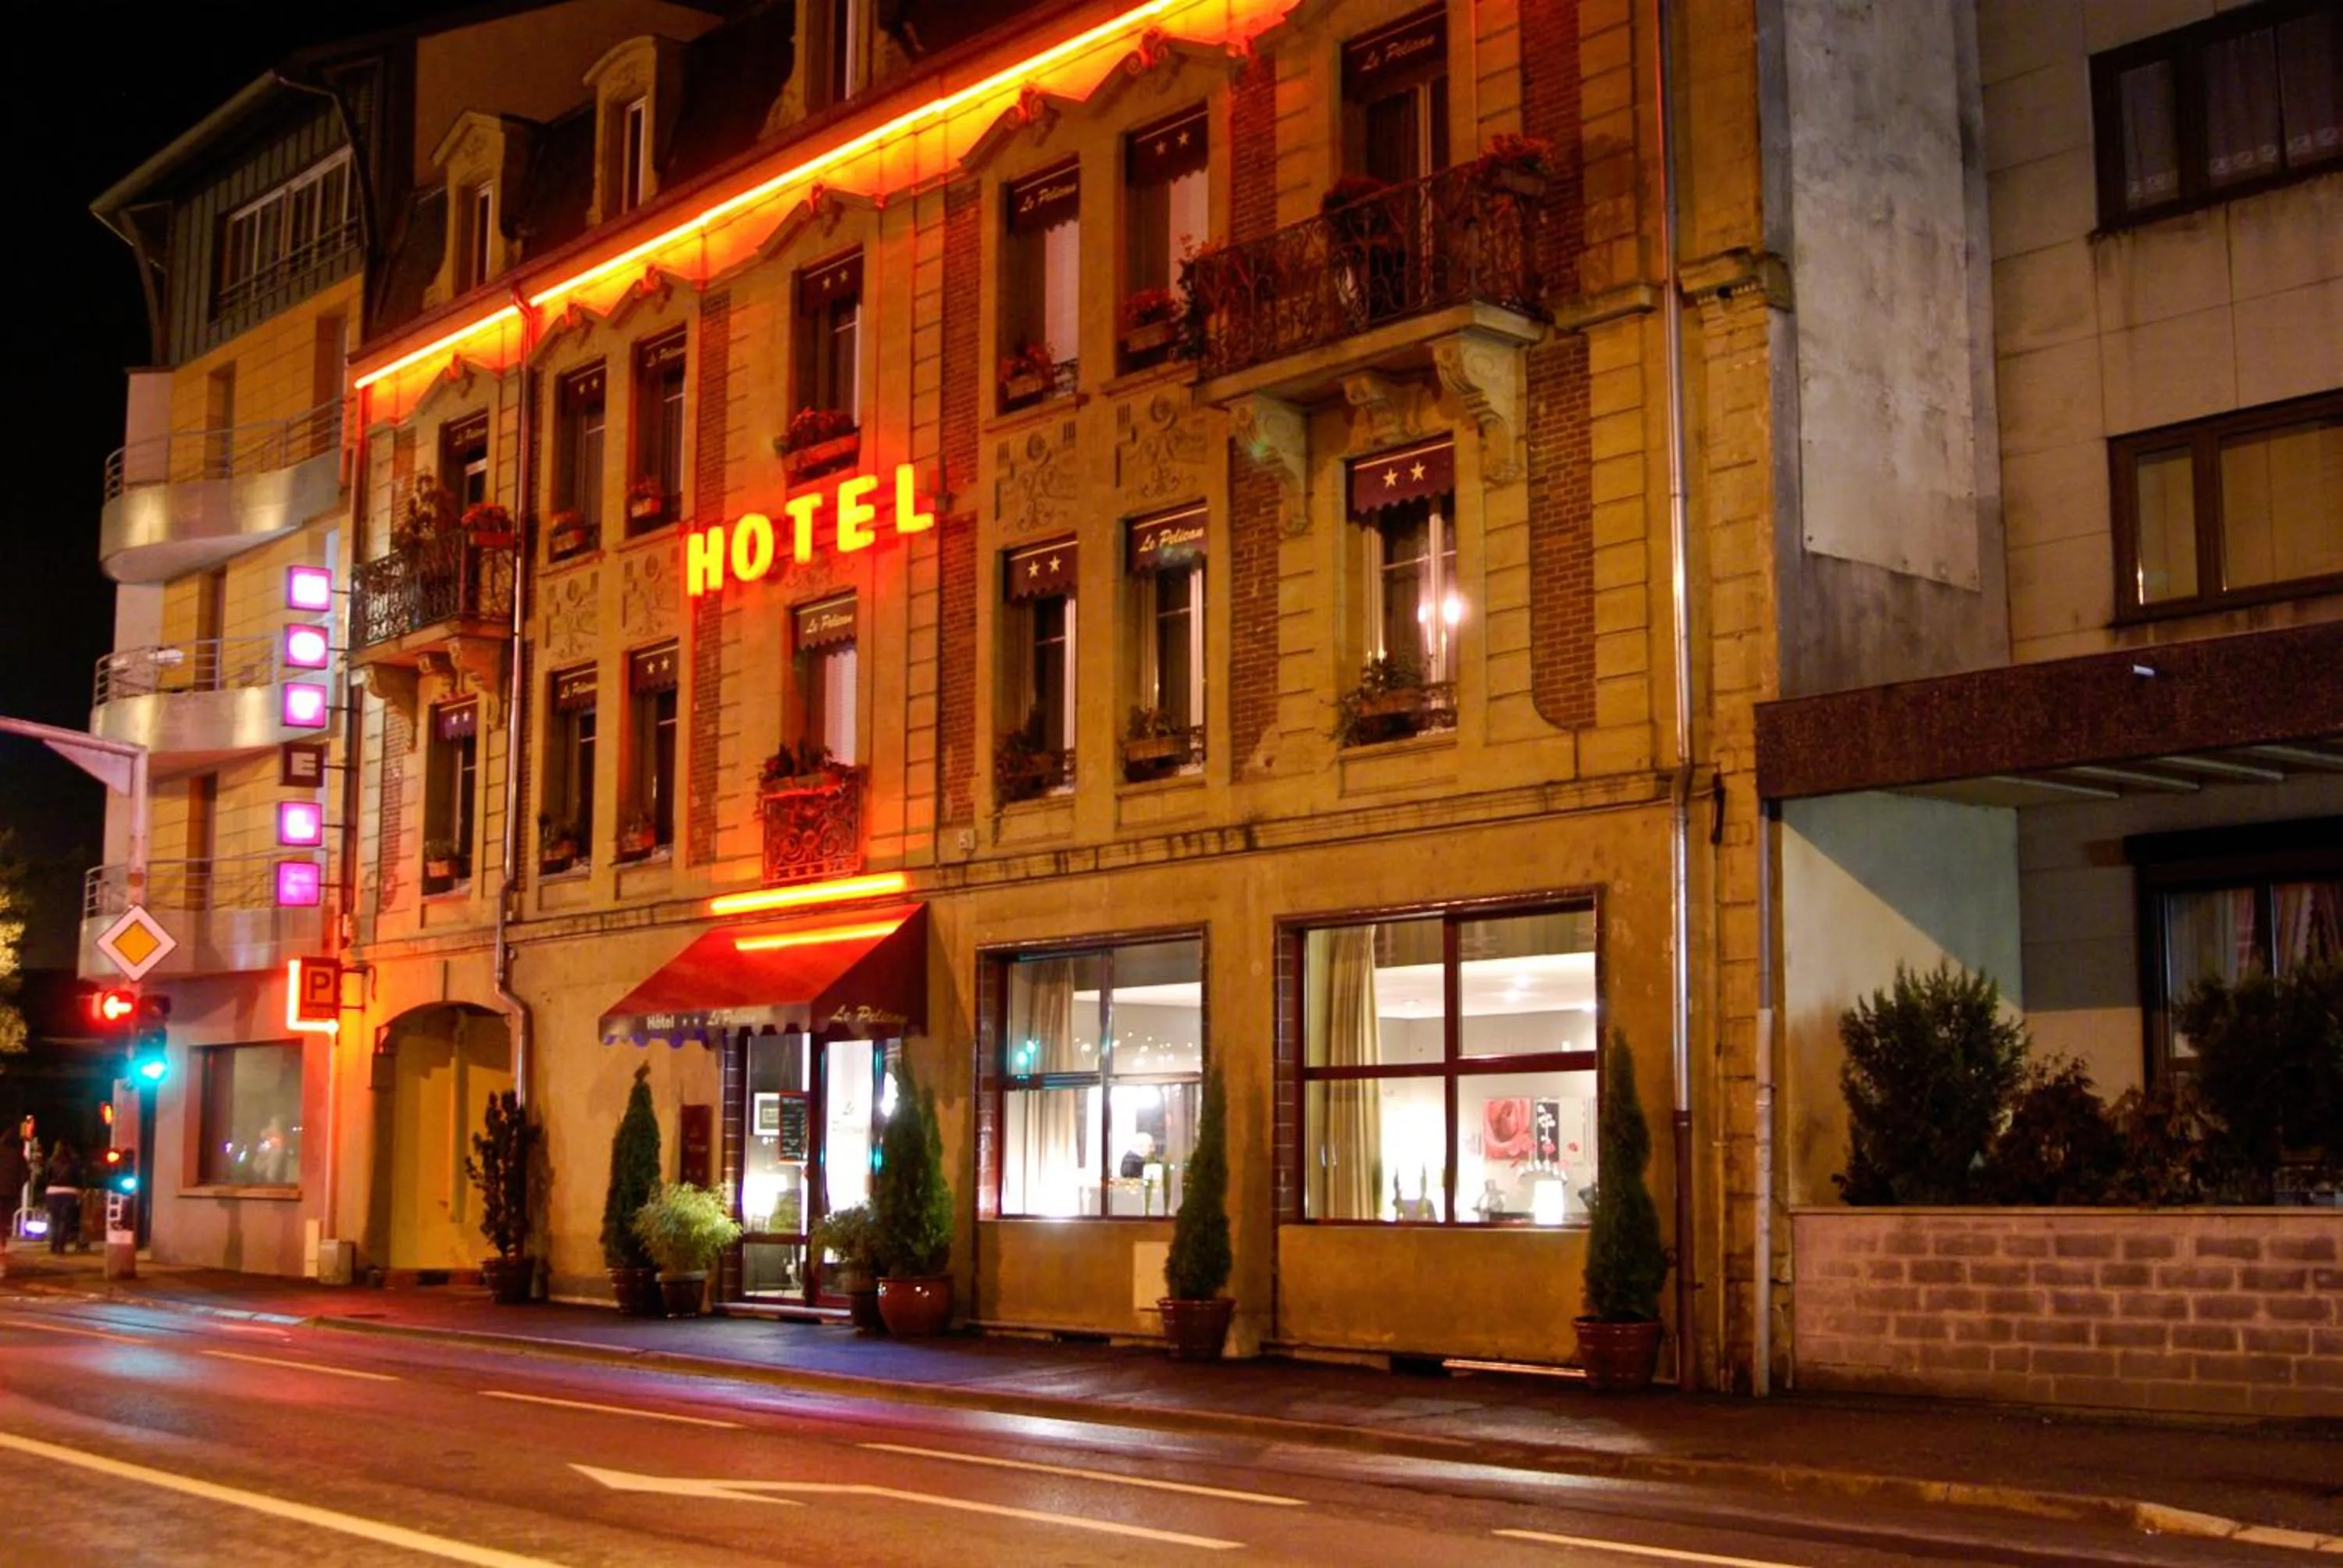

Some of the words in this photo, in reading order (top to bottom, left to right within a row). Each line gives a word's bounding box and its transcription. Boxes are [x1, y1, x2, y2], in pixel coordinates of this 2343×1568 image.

[686, 462, 935, 597] HOTEL
[1139, 533, 1155, 552] Le
[310, 971, 330, 1000] P
[829, 1004, 851, 1022] Le
